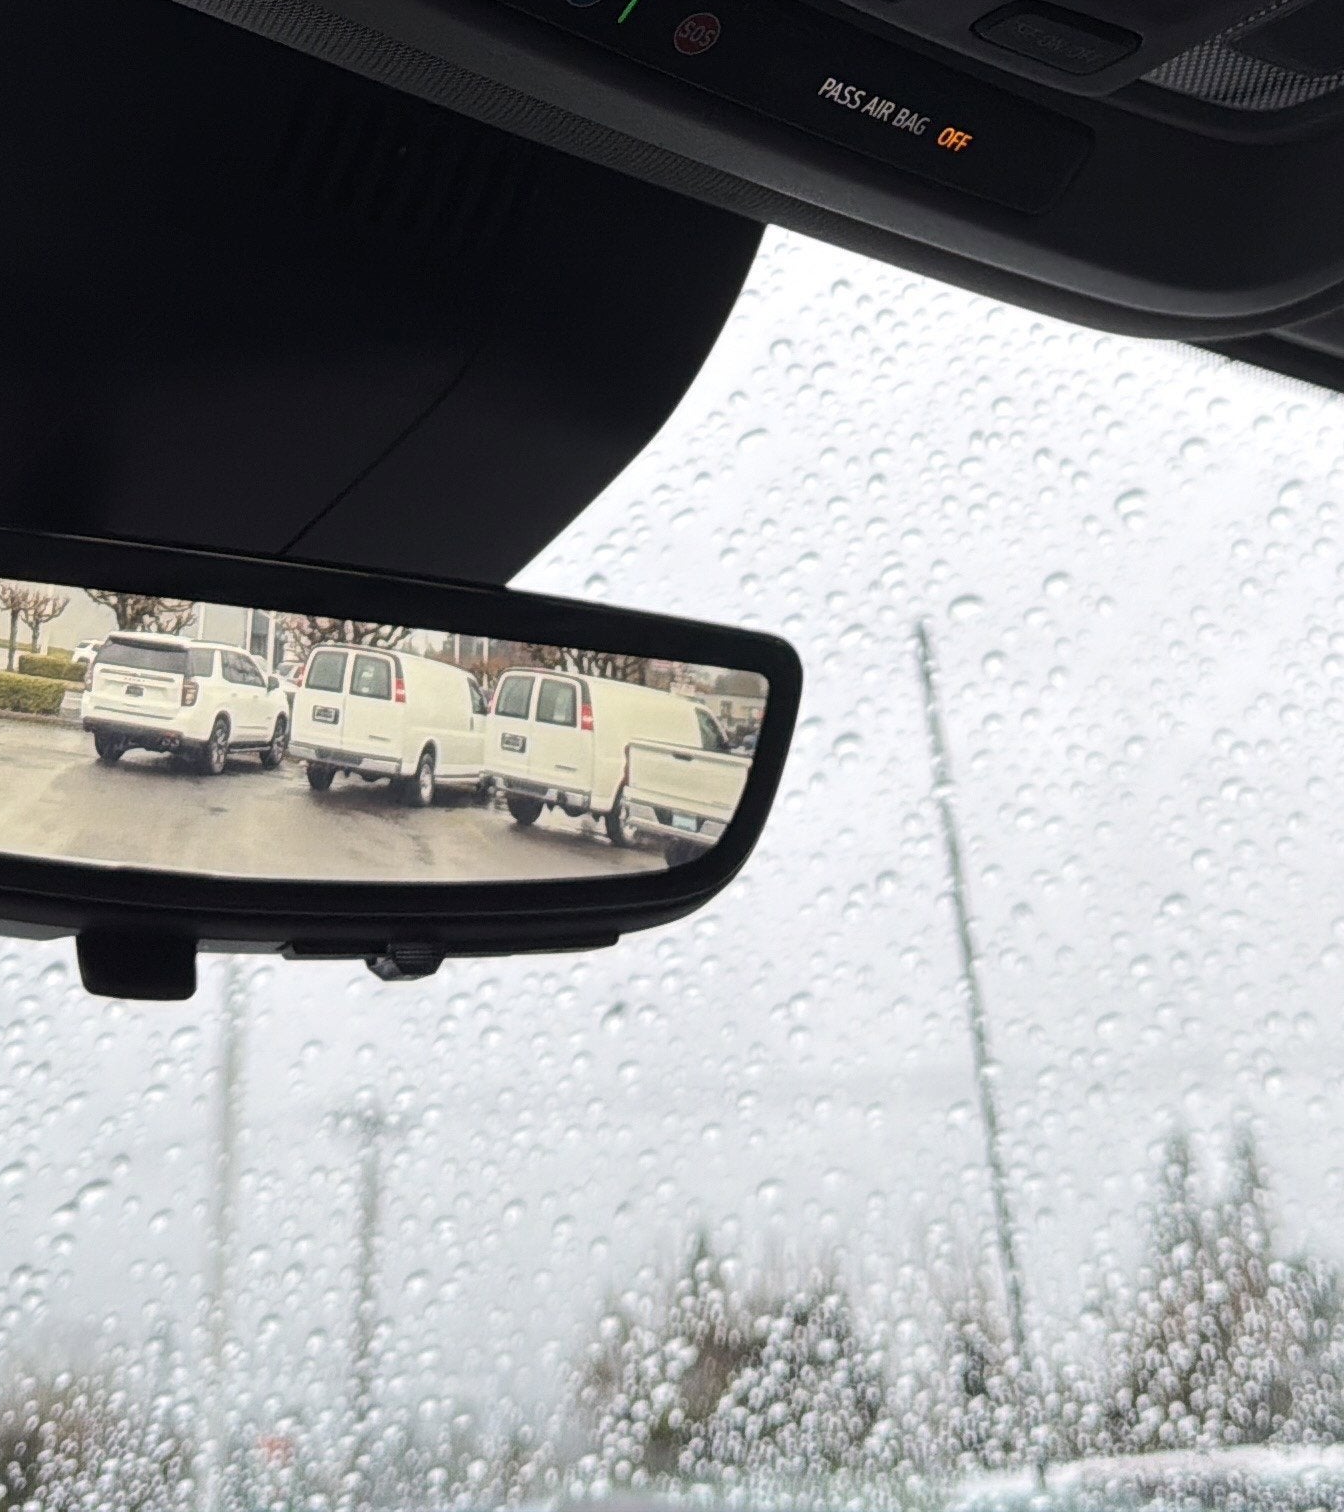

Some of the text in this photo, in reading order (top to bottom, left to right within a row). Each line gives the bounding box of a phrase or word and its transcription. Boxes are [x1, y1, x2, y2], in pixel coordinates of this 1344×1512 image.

[678, 20, 716, 48] SOS
[817, 76, 975, 152] PASS AIR BAG OFF
